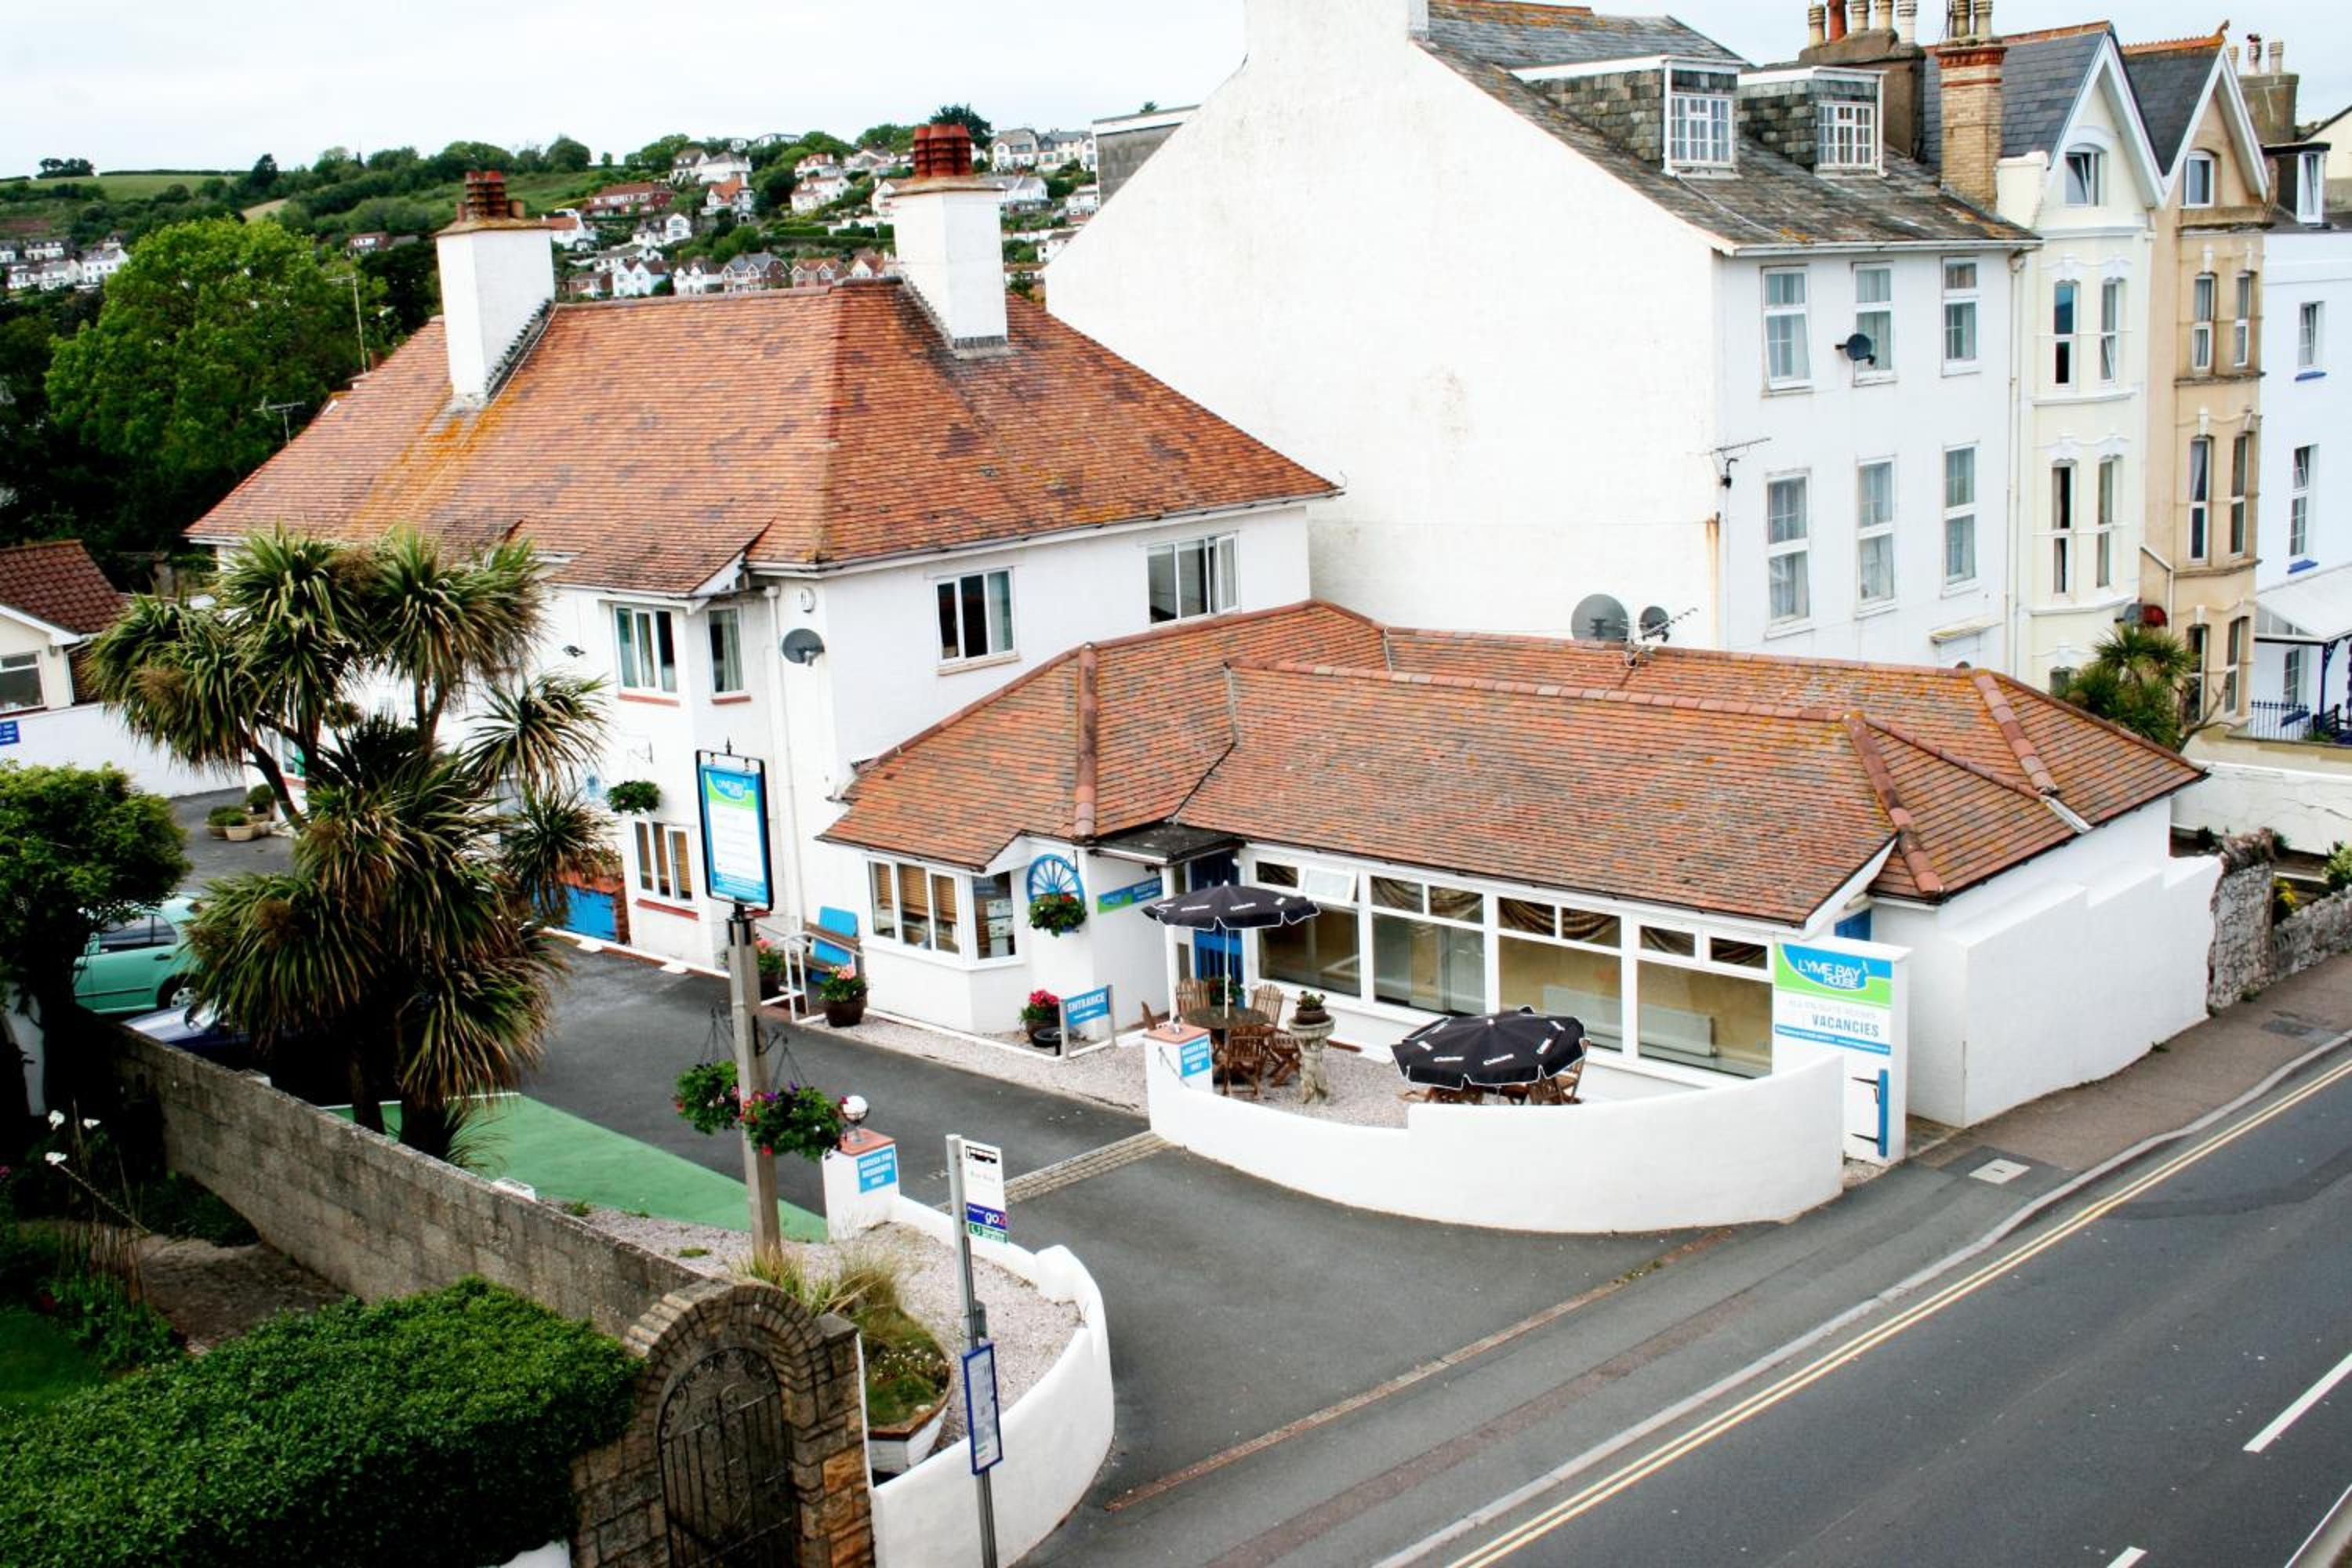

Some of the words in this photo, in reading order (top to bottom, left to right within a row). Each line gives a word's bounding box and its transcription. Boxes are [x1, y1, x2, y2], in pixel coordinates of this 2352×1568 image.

[1798, 959, 1832, 975] LYME
[1835, 964, 1862, 978] BAY
[1067, 992, 1105, 1014] ENTRANCE
[1812, 1014, 1879, 1037] VACANCIES
